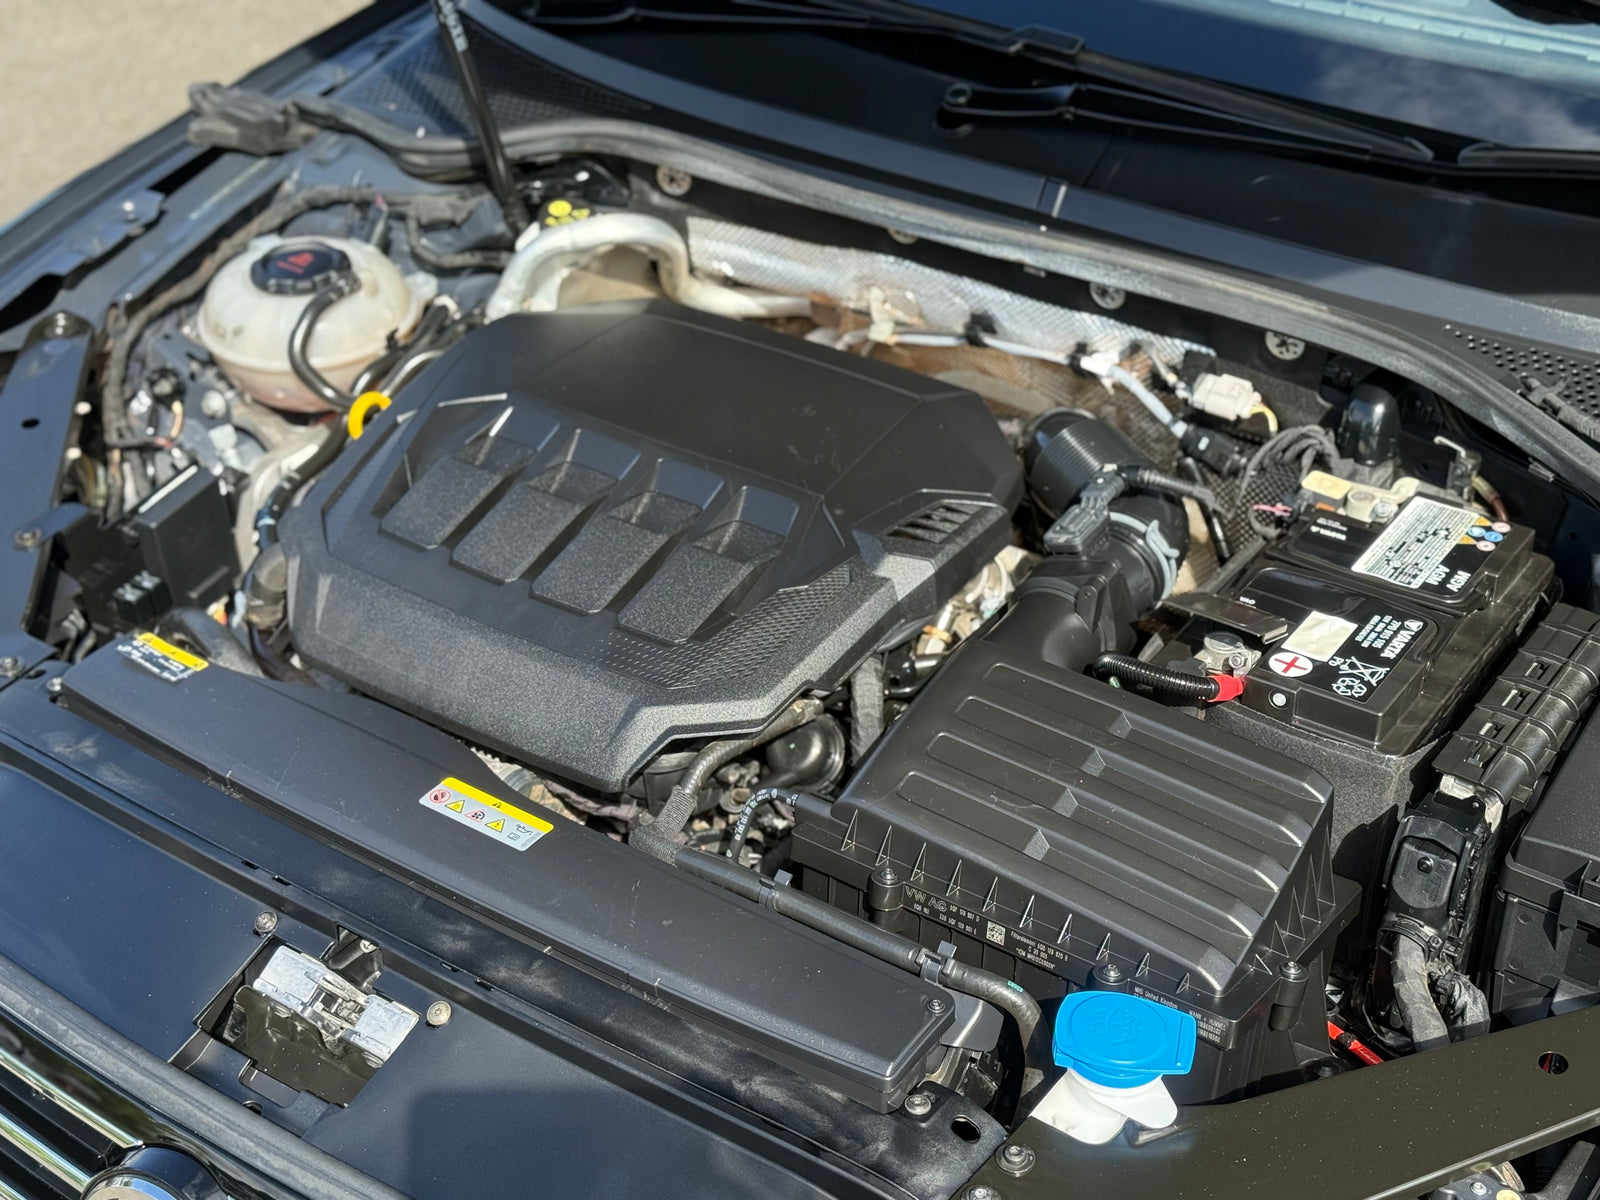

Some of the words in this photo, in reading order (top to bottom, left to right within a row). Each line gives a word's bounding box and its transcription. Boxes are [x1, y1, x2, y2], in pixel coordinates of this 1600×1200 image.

[1425, 564, 1450, 585] AGM
[1446, 570, 1471, 592] AGM
[1380, 629, 1394, 640] 915
[1380, 630, 1415, 660] VARTA
[905, 885, 927, 903] VW
[928, 897, 948, 912] AG
